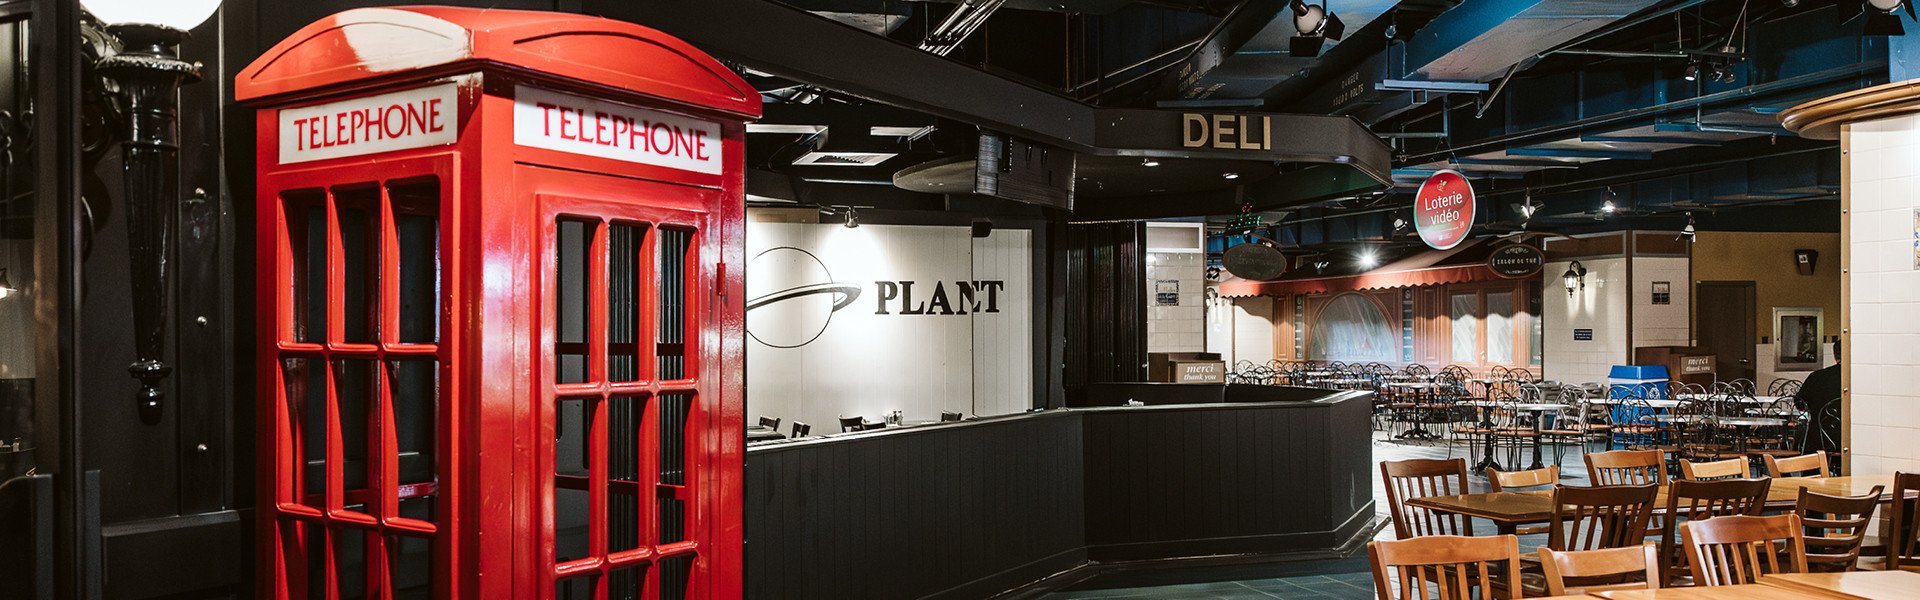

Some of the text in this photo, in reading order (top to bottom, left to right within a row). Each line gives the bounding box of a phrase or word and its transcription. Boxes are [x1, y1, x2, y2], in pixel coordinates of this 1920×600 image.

[294, 98, 444, 151] TELEPHONE
[537, 102, 710, 162] TELEPHONE
[1183, 113, 1271, 150] DELI
[1424, 191, 1463, 211] Loterie
[1430, 208, 1460, 225] vidéo
[1186, 363, 1214, 373] merci
[1687, 356, 1709, 365] merci
[1183, 373, 1204, 381] thank
